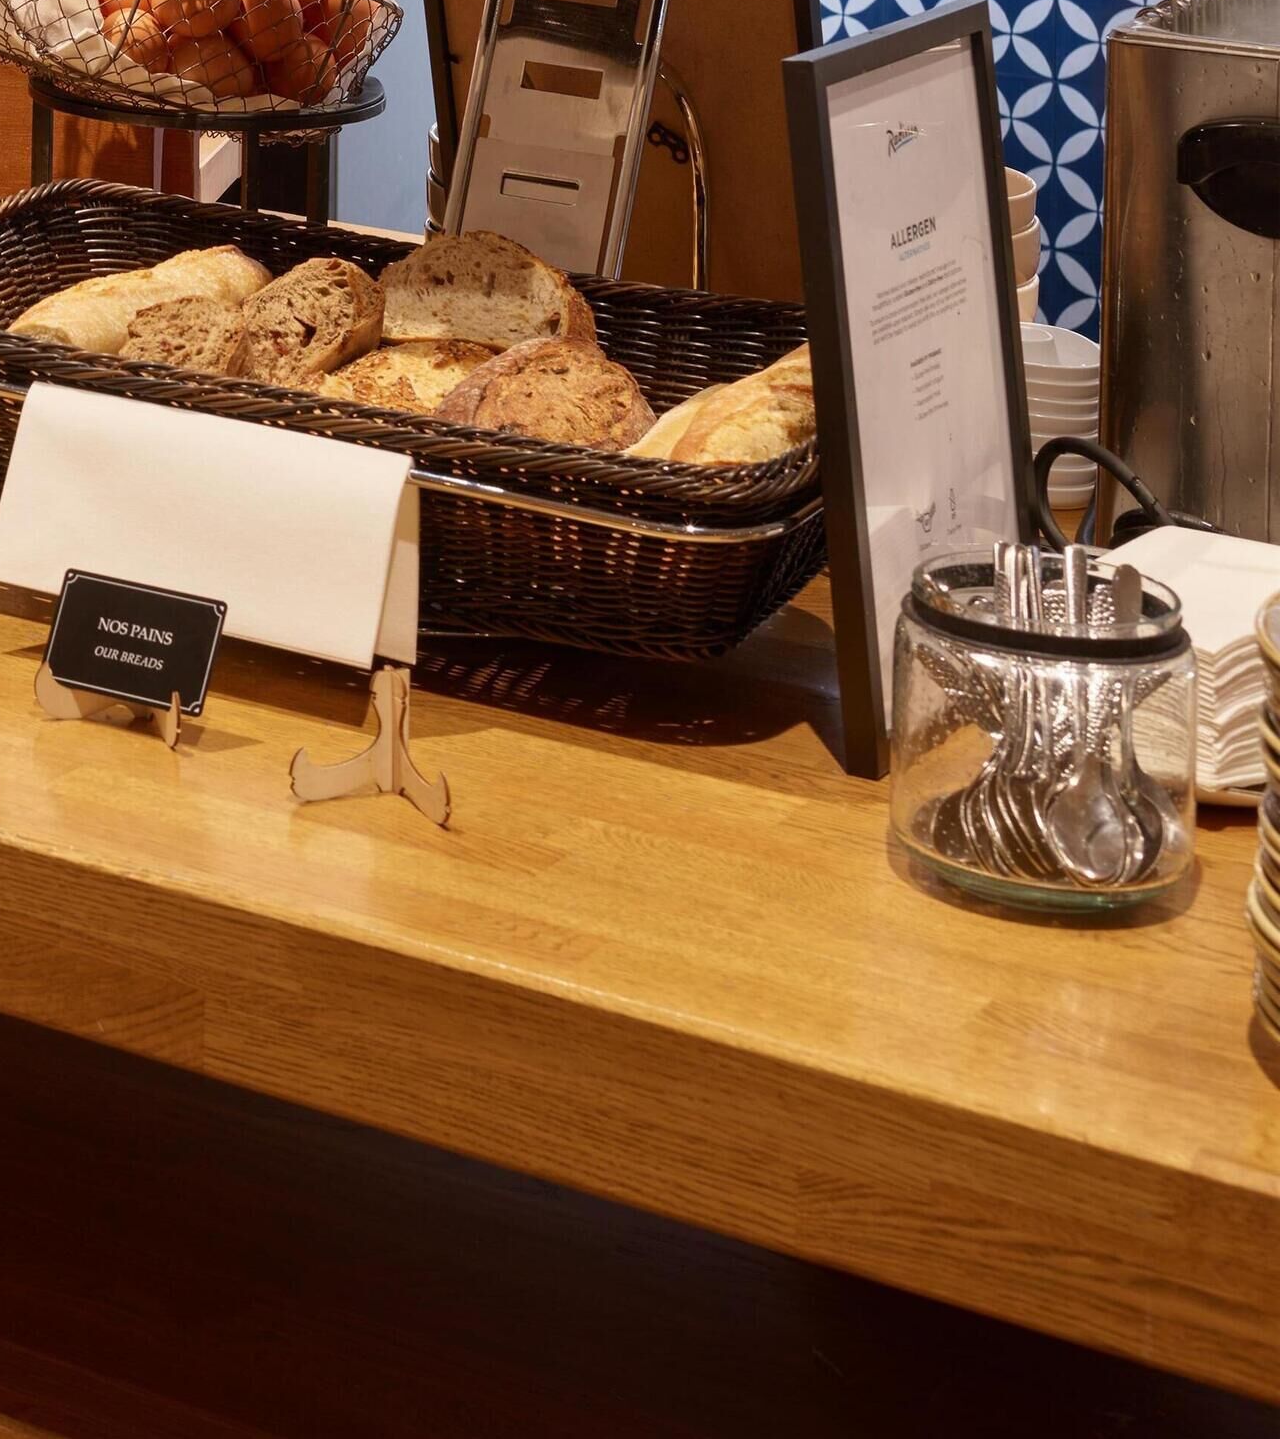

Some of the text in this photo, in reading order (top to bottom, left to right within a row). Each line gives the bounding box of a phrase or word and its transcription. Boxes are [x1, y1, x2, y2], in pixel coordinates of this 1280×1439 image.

[890, 216, 937, 249] ALLERGEN
[97, 616, 174, 646] NOS PAINS
[94, 645, 165, 671] OUR BREADS
